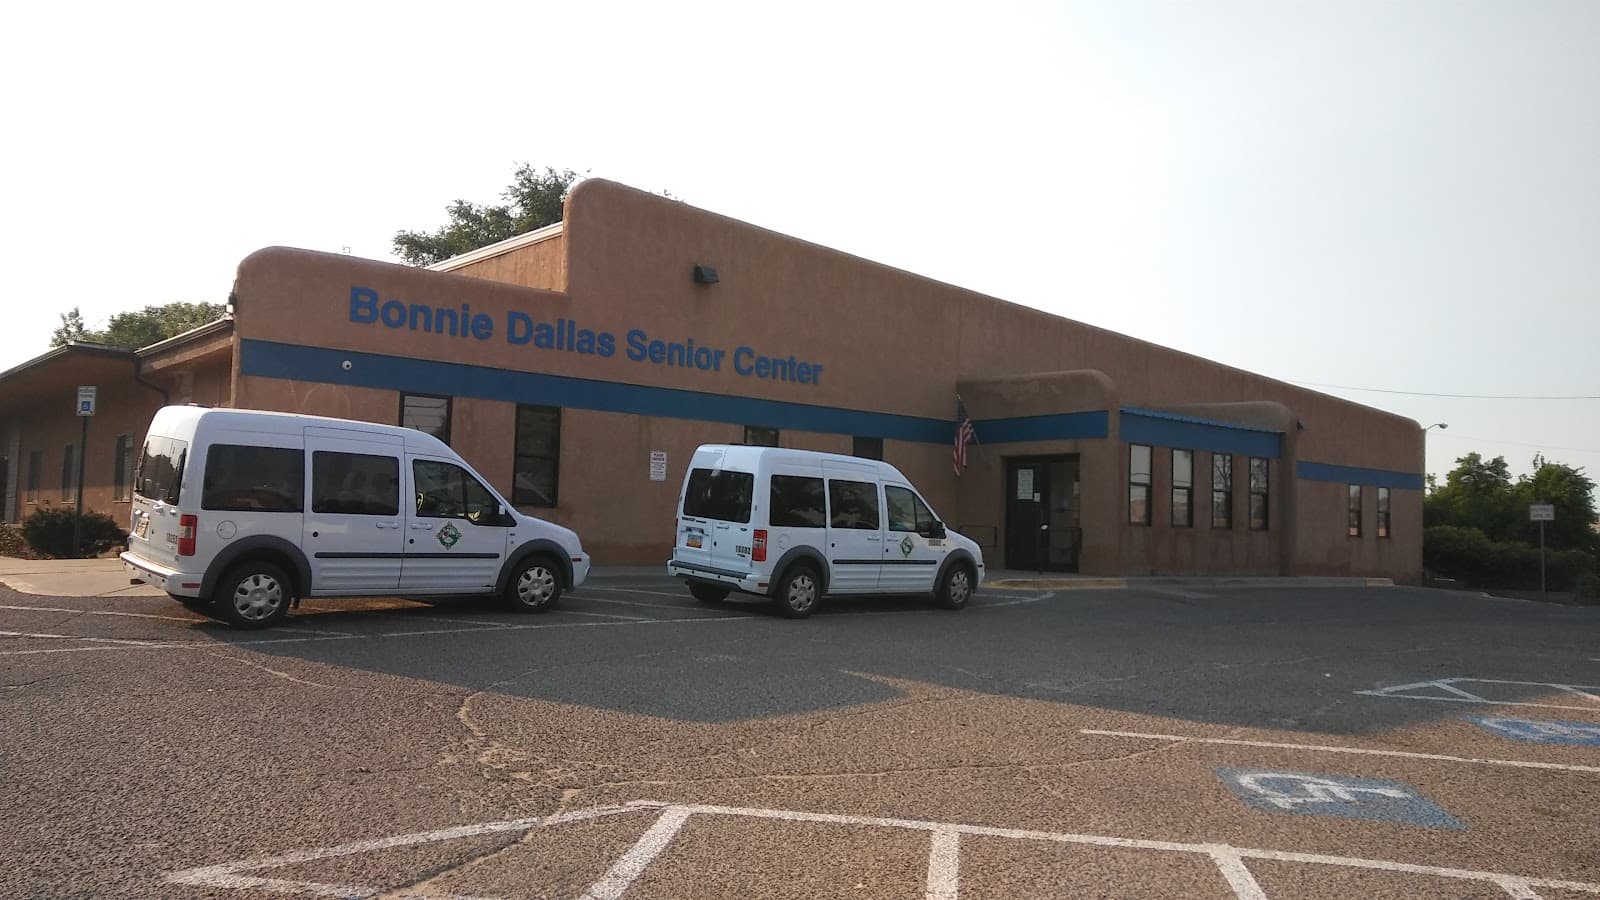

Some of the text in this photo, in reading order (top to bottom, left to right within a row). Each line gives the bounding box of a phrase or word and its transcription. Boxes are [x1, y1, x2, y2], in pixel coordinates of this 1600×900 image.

[349, 286, 823, 385] Bonnie Dallas Senior Center
